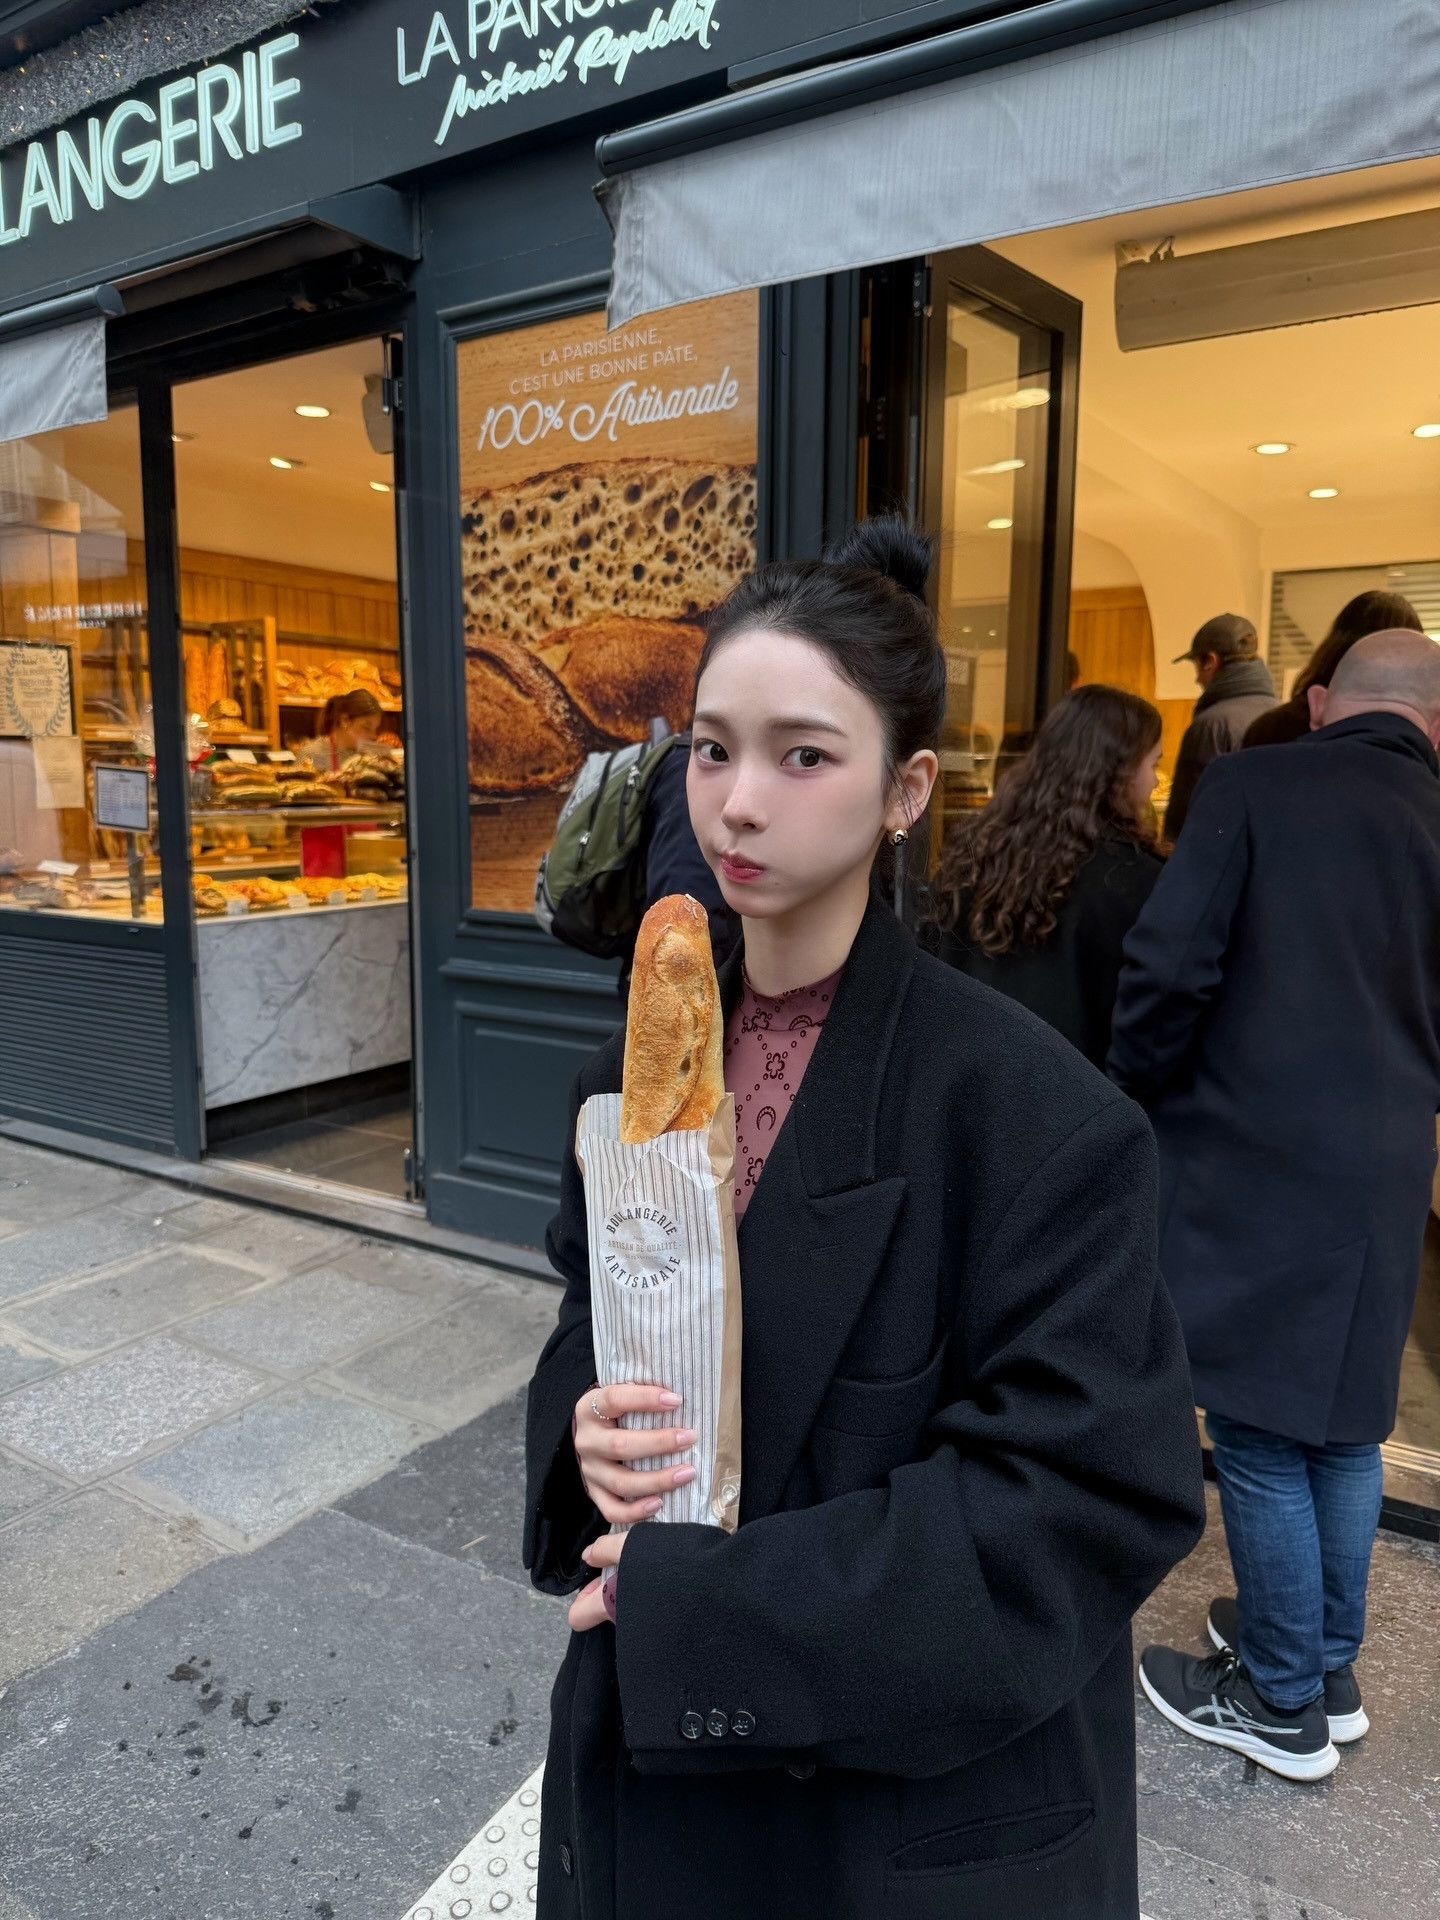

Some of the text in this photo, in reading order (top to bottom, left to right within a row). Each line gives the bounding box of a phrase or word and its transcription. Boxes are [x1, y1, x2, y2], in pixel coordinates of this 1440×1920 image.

[397, 11, 461, 86] LA
[432, 34, 575, 146] Mickaël
[509, 373, 549, 396] C'EST
[552, 365, 585, 387] UNE
[590, 353, 649, 381] BONNE
[540, 347, 560, 368] LA
[477, 364, 740, 452] 100% Artisanale
[605, 1207, 678, 1236] BOULANGERIE
[607, 1239, 634, 1252] ARTISAN
[635, 1243, 645, 1253] DE
[604, 1254, 682, 1289] ARTISANALE
